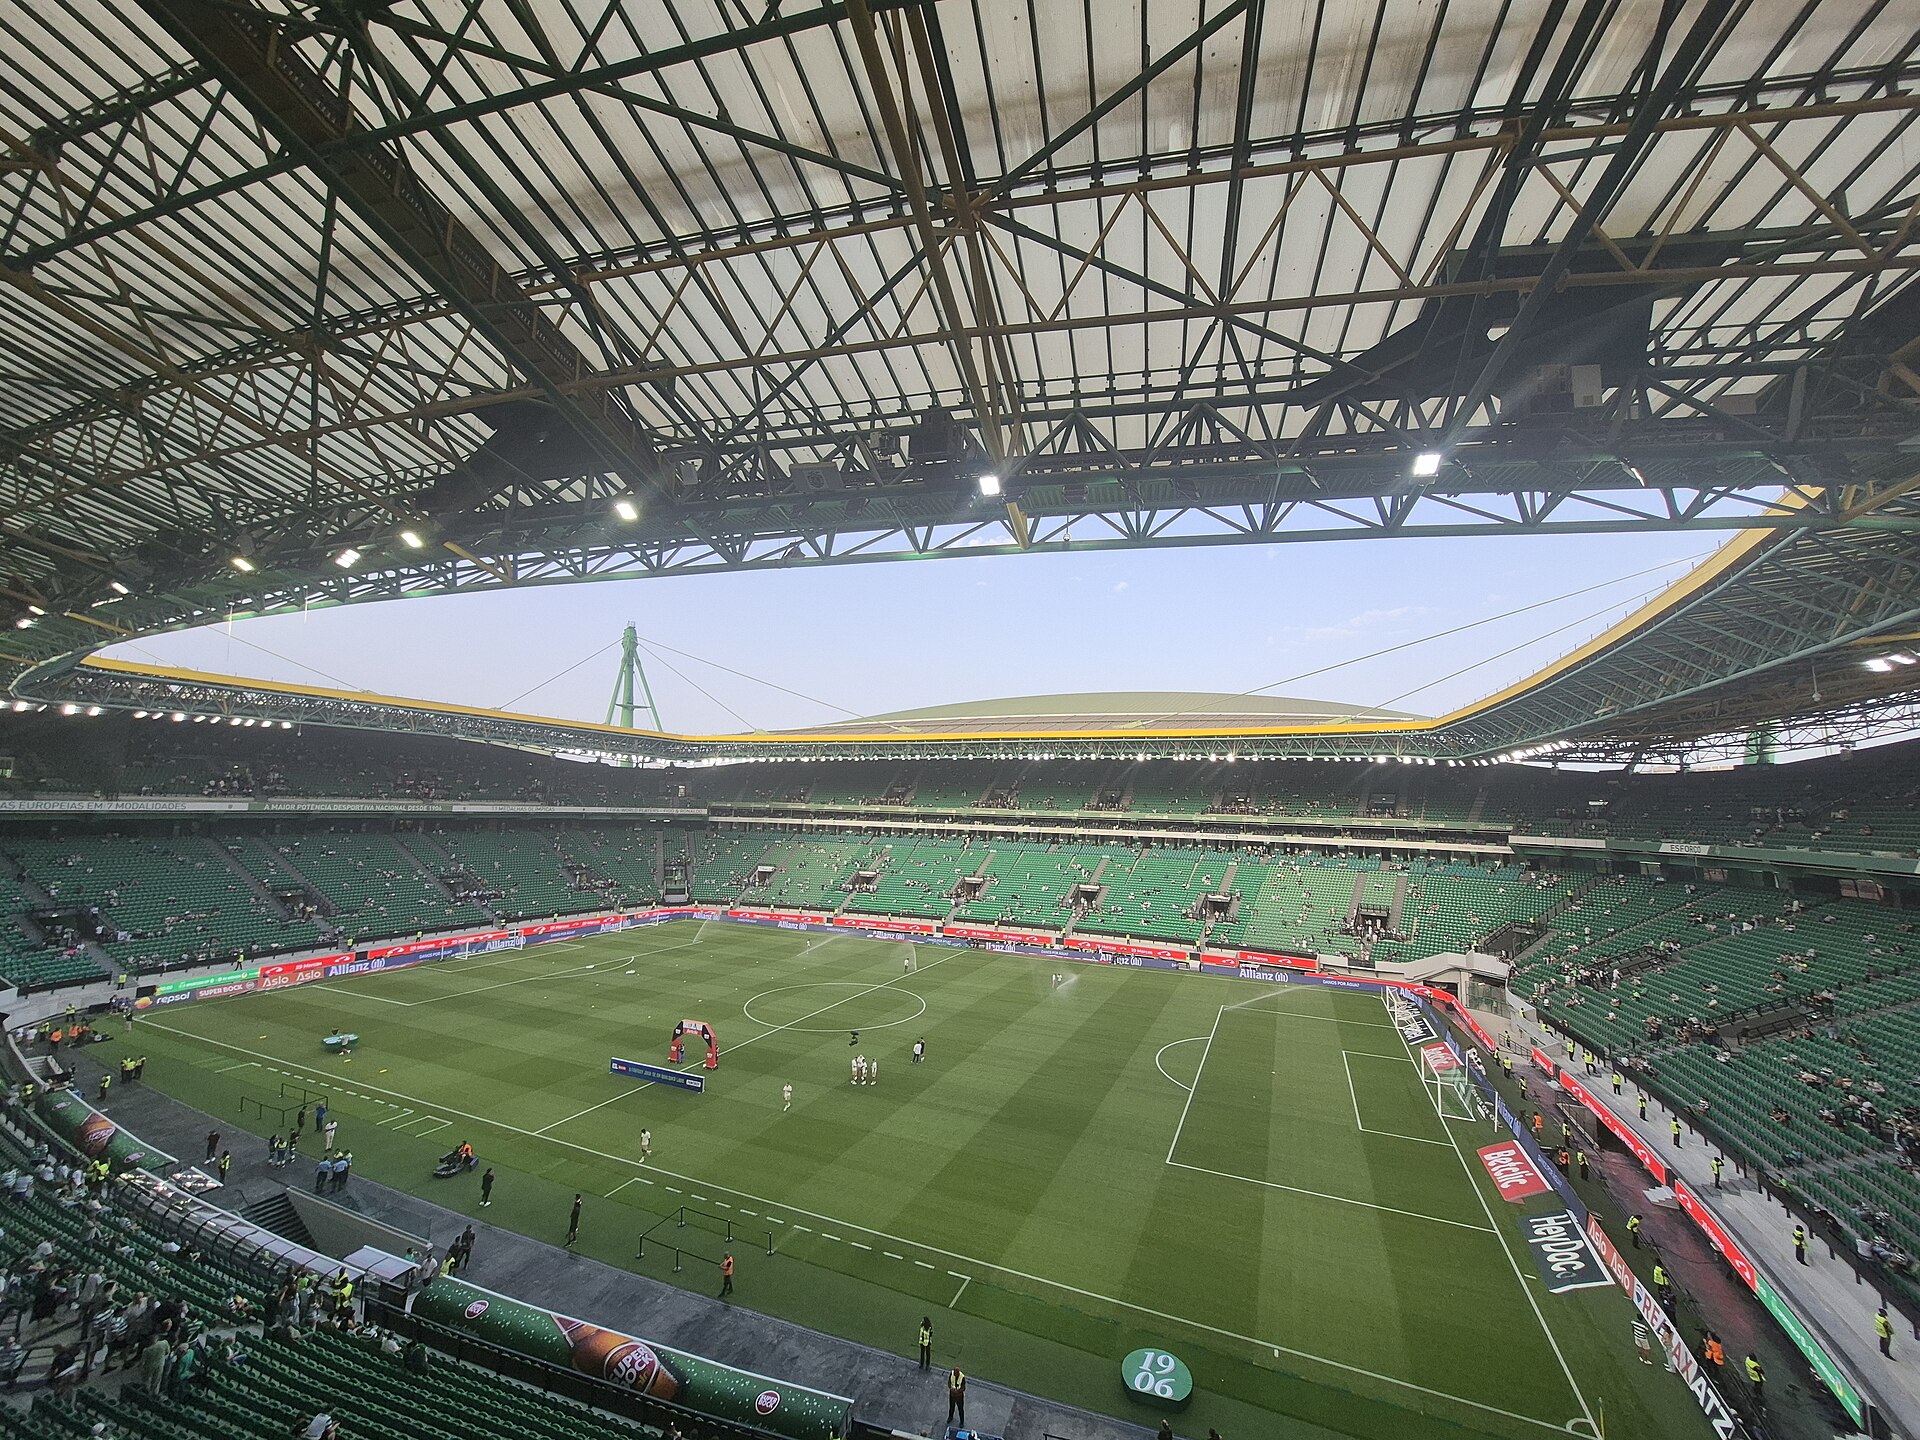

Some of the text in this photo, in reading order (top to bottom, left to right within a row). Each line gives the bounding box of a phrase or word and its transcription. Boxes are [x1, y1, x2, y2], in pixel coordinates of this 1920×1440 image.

[18, 802, 85, 810] EUROPEIAS
[87, 802, 103, 810] EM
[107, 802, 113, 810] 7
[114, 802, 187, 810] MODALIDADES
[777, 921, 799, 929] Allianz
[328, 961, 370, 976] Allianz
[1239, 968, 1274, 980] Allianz
[199, 987, 222, 997] SUPER
[223, 983, 243, 992] BOCK
[156, 991, 190, 1004] repsol
[1483, 1149, 1535, 1189] Betclic
[1138, 1351, 1176, 1375] 19
[1134, 1371, 1176, 1399] 06
